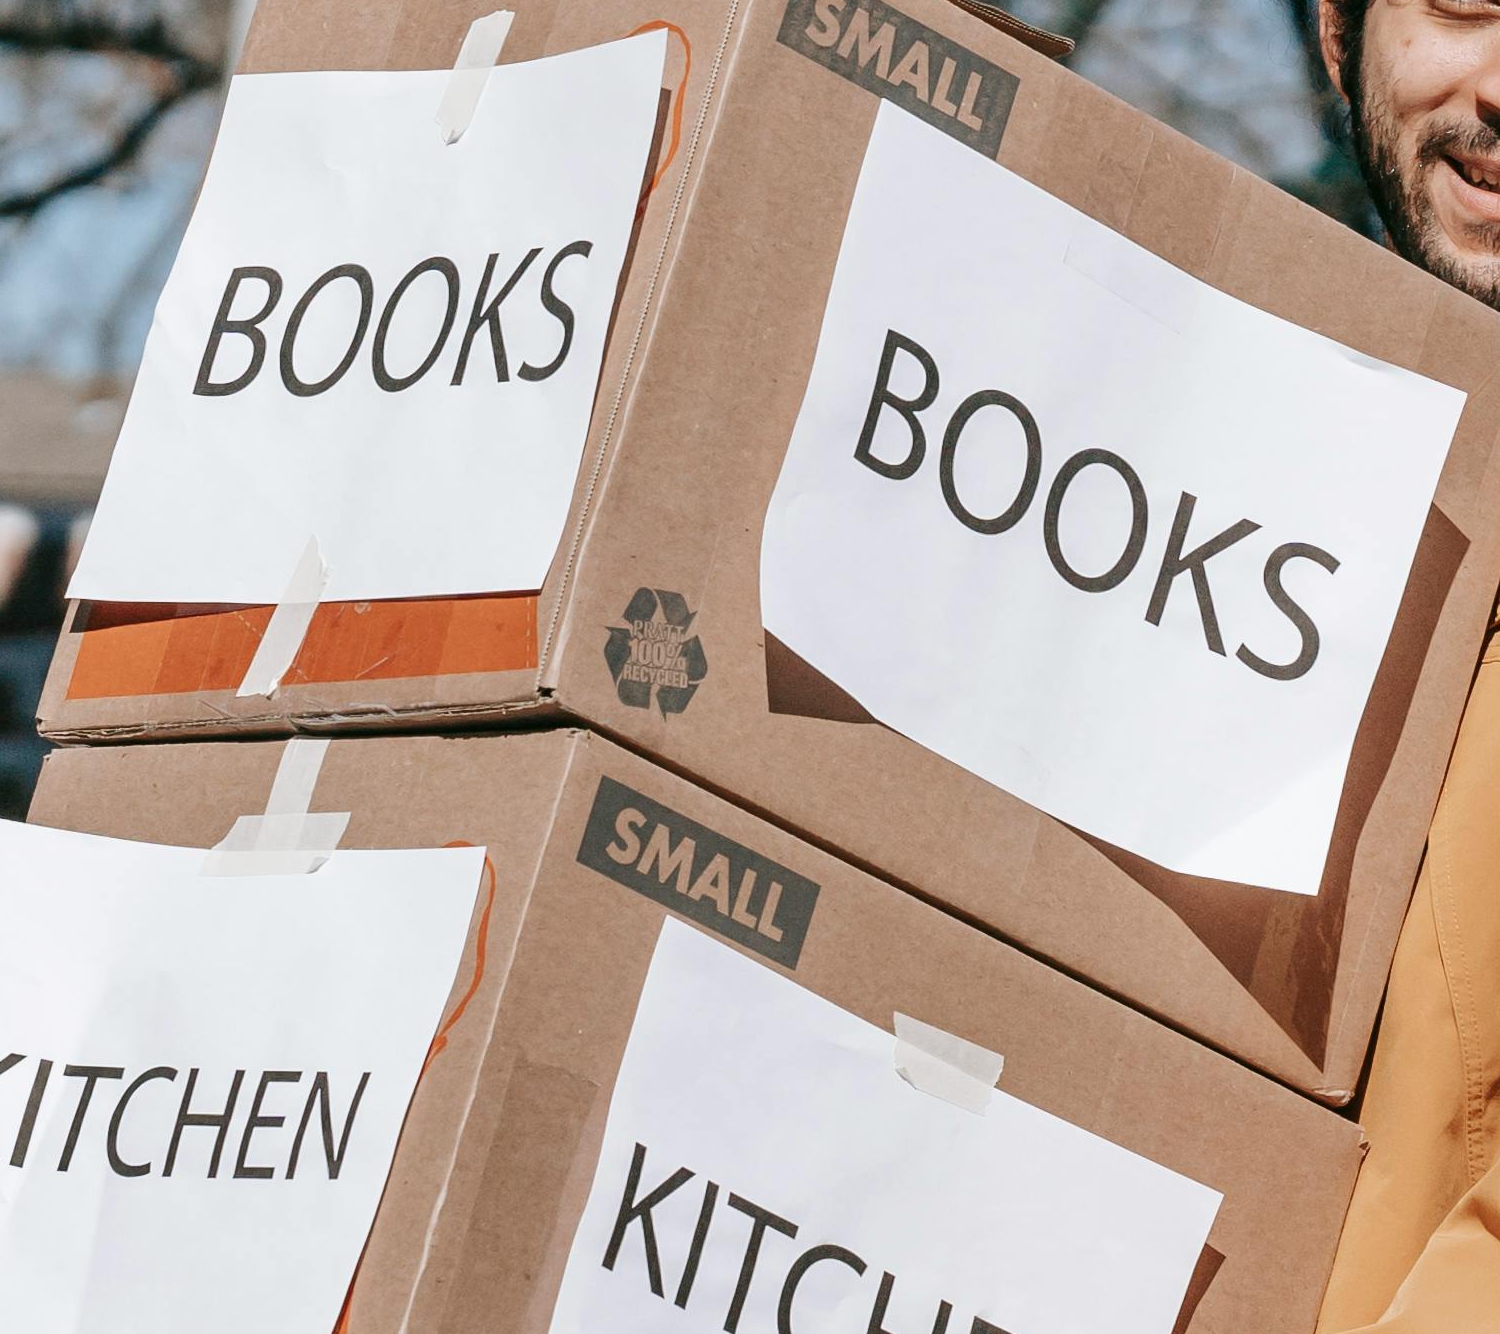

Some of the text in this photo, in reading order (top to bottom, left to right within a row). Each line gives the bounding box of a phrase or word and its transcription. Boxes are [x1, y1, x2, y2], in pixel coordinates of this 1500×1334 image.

[192, 240, 593, 397] BOOKS
[853, 328, 1341, 681] BOOKS
[629, 639, 687, 672] 100%
[633, 619, 685, 642] PRATT
[623, 663, 689, 689] RECYCLED
[604, 807, 784, 943] SMALL
